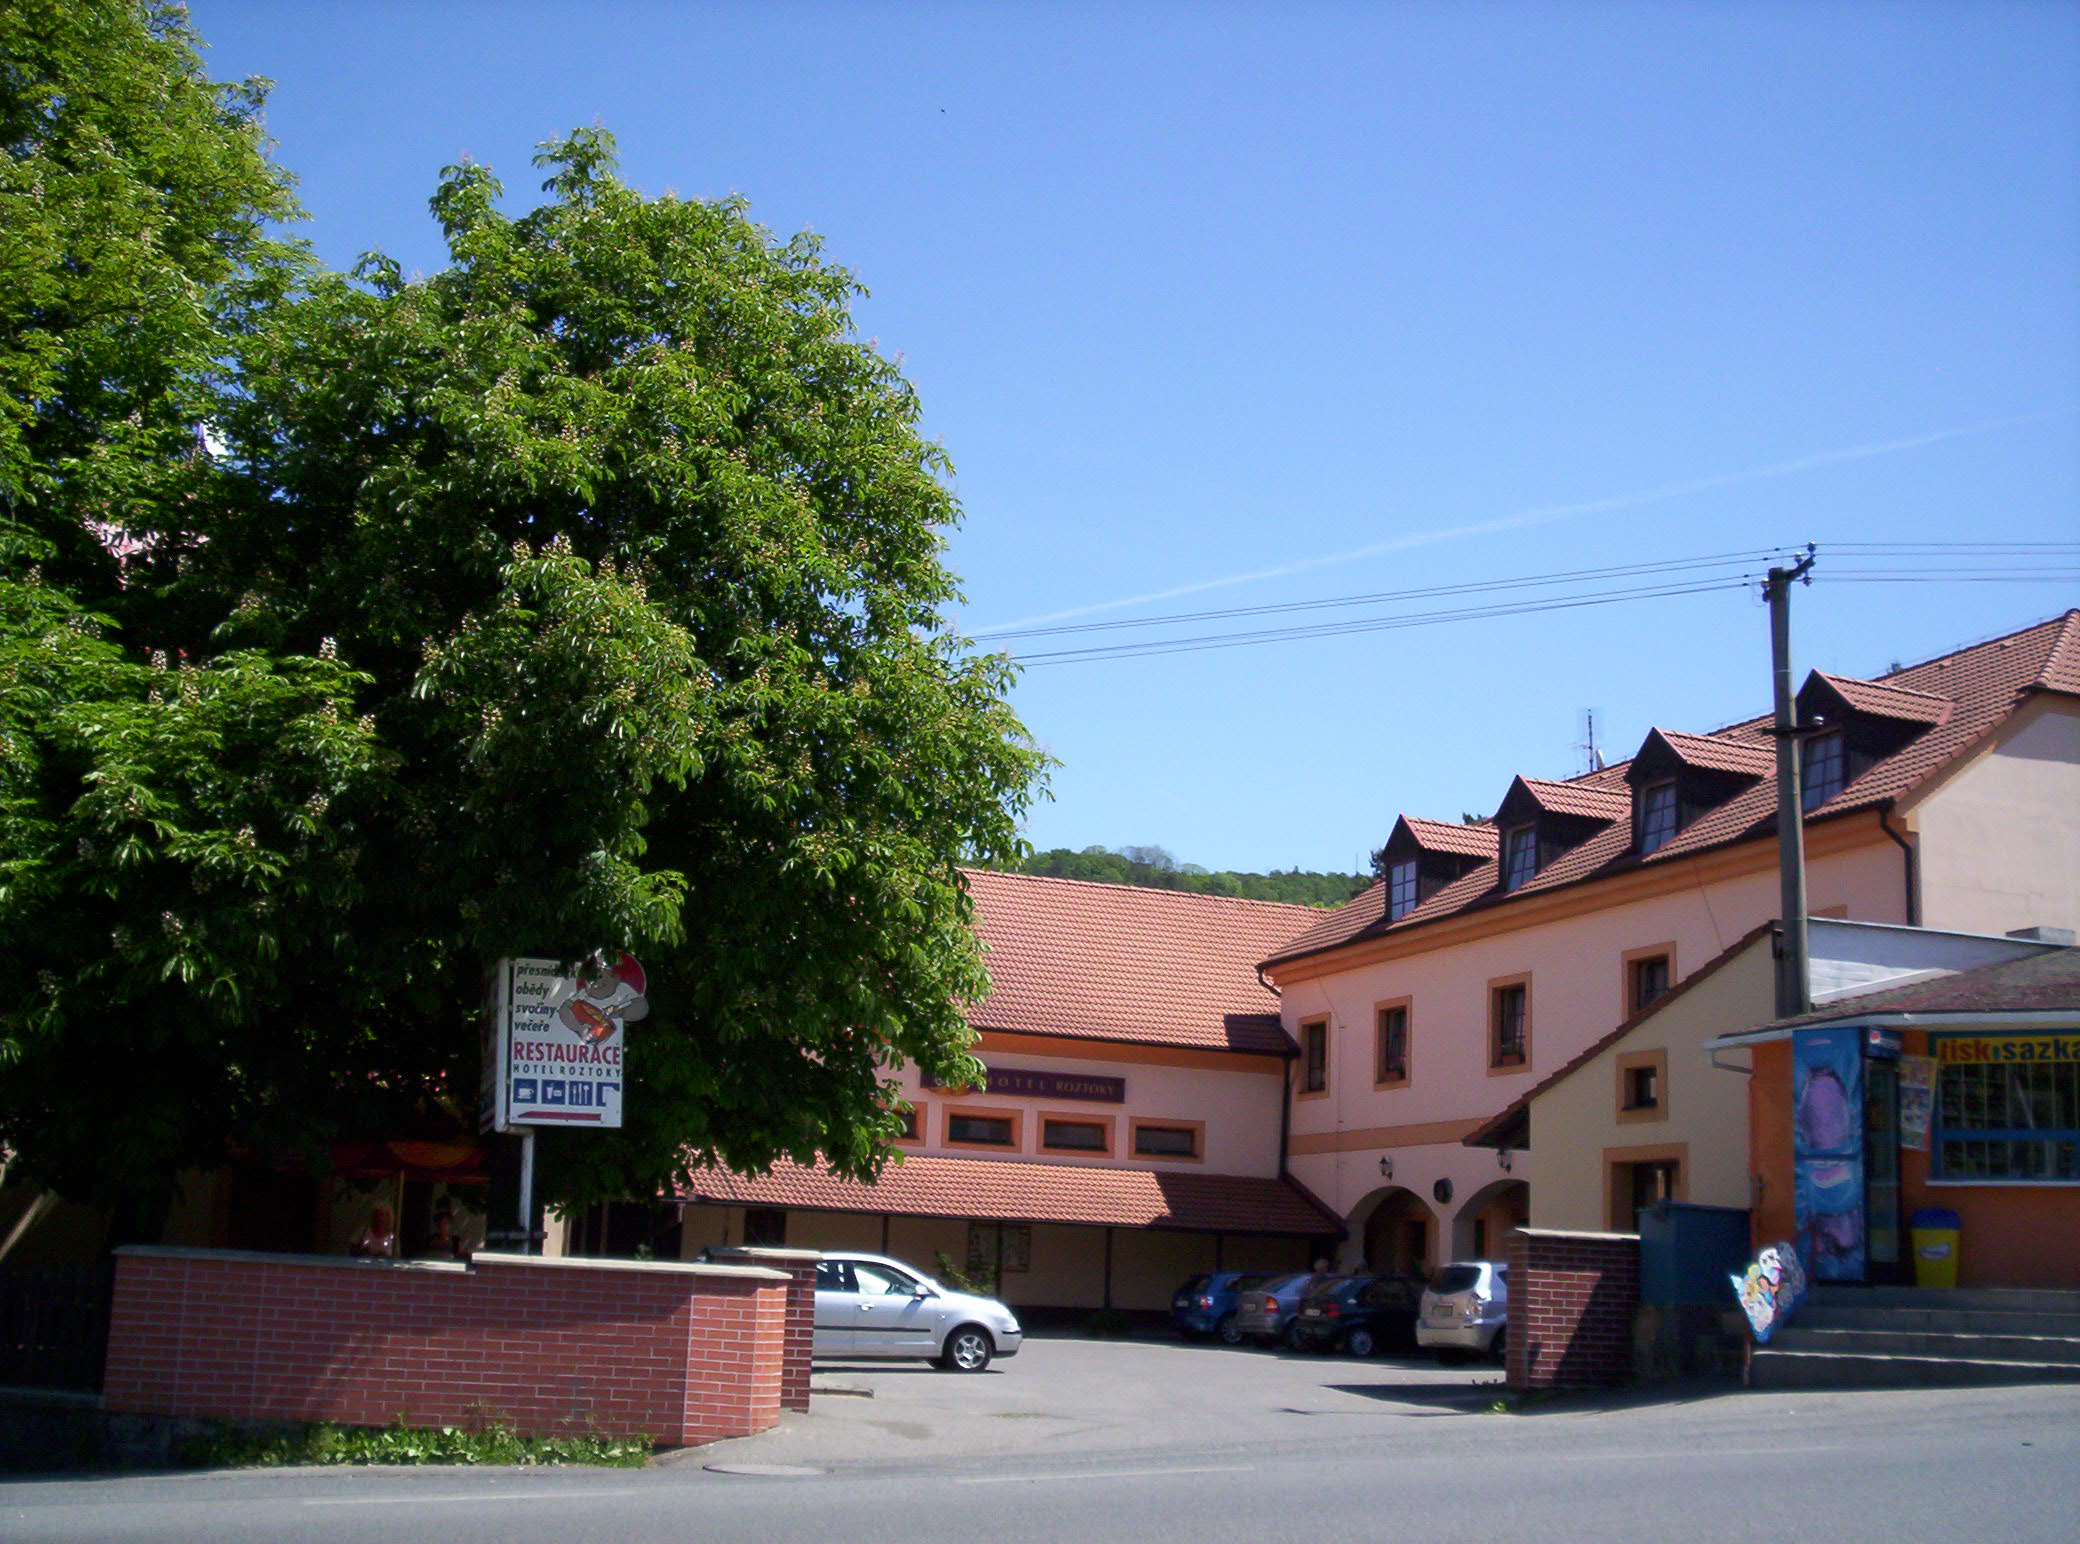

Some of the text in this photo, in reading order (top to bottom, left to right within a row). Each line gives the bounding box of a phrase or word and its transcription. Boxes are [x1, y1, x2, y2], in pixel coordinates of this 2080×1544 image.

[515, 982, 549, 1000] obědy
[515, 1002, 557, 1019] svačiny
[514, 1020, 550, 1032] večeře
[513, 1041, 620, 1065] RESTAURACE
[513, 1064, 621, 1077] HOTEL ROZTOKY
[1055, 1080, 1114, 1095] ROZTOKY
